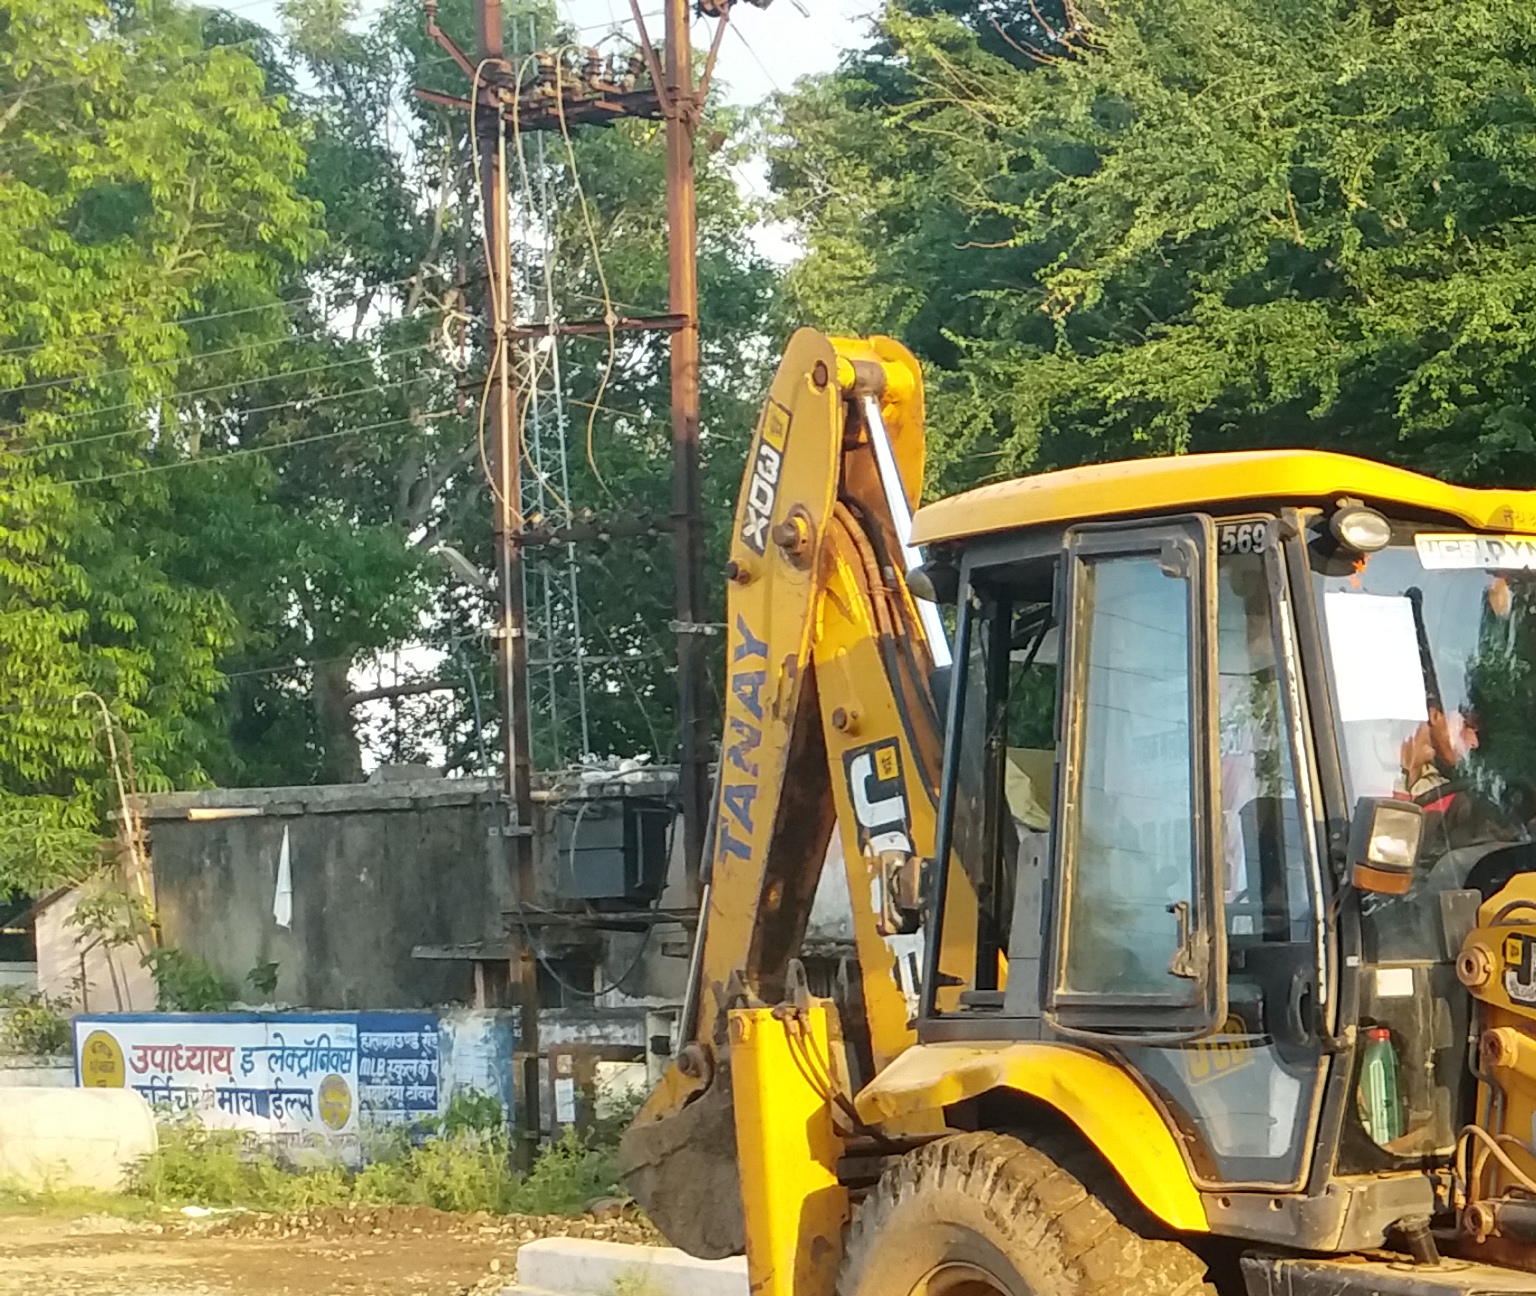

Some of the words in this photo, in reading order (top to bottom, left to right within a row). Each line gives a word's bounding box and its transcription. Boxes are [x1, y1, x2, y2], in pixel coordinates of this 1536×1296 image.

[743, 444, 781, 550] 3DX
[1221, 524, 1266, 554] 569
[719, 612, 769, 863] TANAY
[129, 1044, 235, 1076] उपाध्याय
